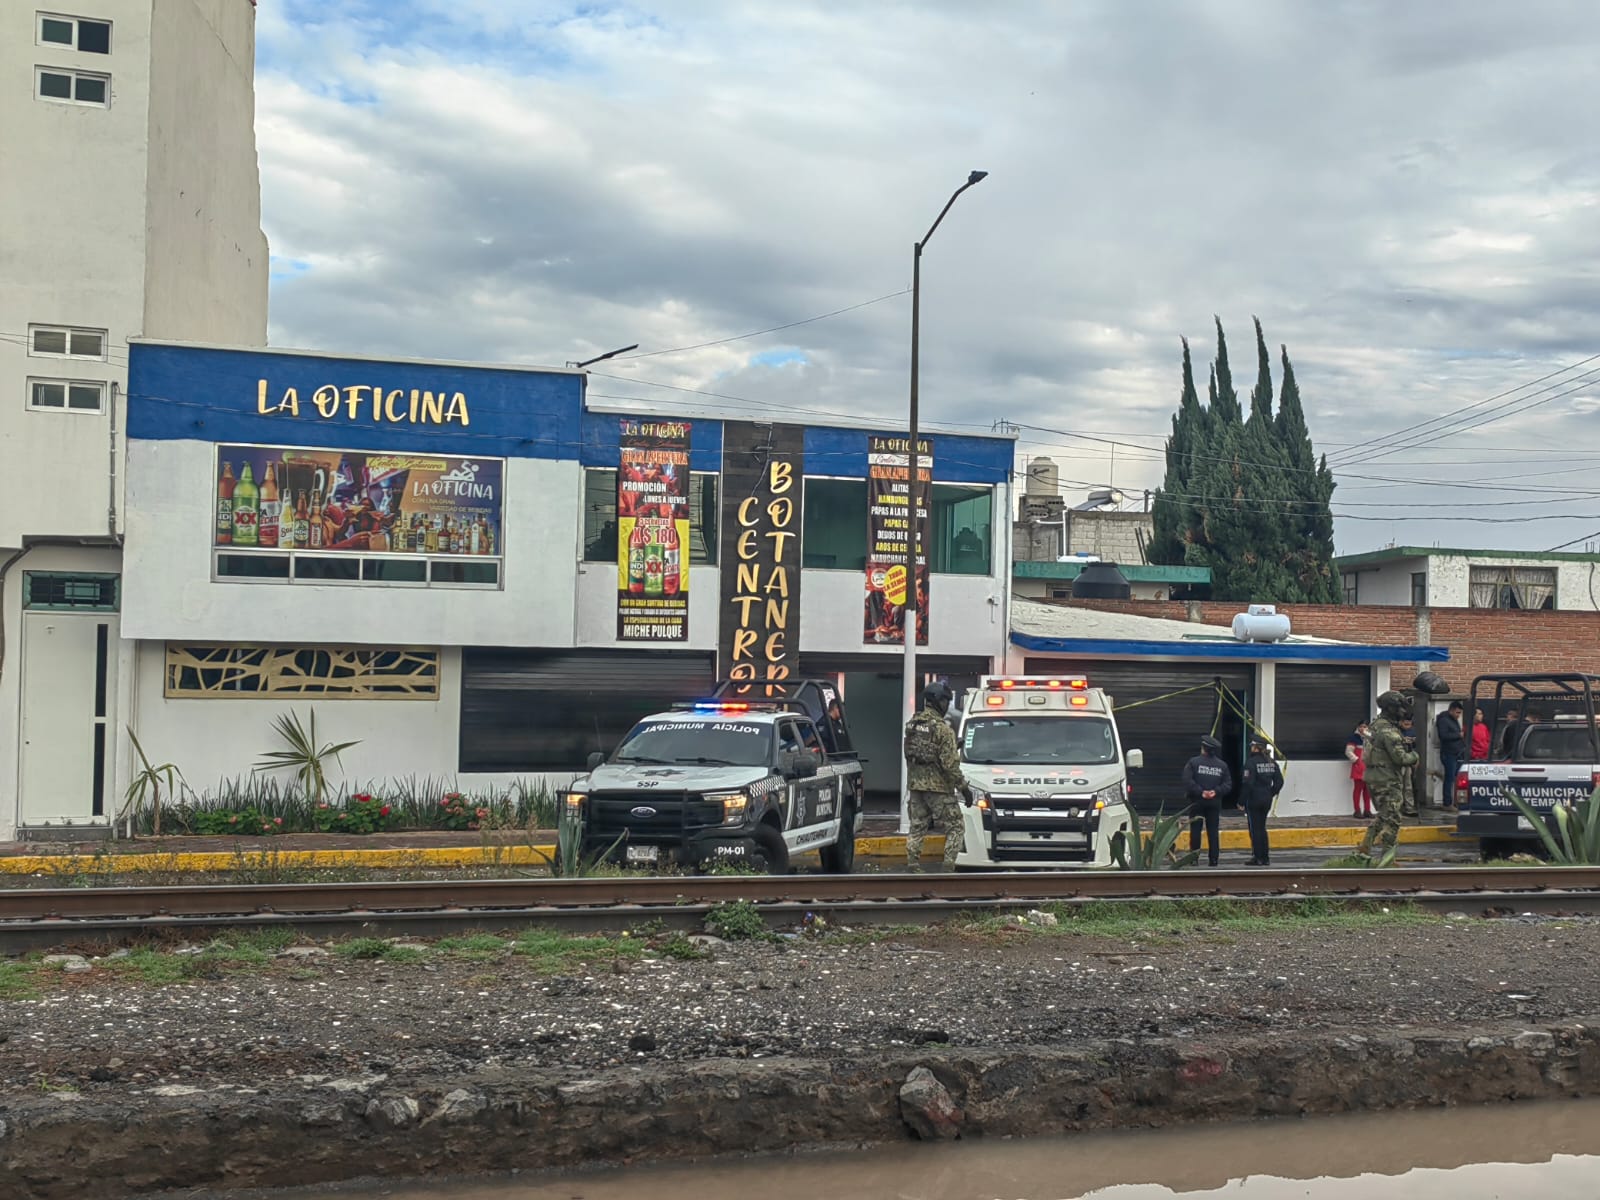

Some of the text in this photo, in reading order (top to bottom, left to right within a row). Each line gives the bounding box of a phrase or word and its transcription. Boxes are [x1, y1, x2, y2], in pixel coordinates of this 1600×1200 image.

[257, 379, 469, 426] LA OFICINA
[888, 439, 928, 453] OFICNA
[413, 480, 493, 500] LA OFICINA
[623, 481, 667, 493] PROMOCIÓN
[655, 528, 676, 544] 180
[730, 496, 763, 694] CENTRO
[624, 625, 682, 639] MICHE PULQUE
[992, 777, 1089, 785] SEMEFO
[1521, 787, 1591, 798] MUNICIPAL
[1490, 797, 1570, 807] CHITEMPAN
[718, 846, 745, 855] PM-01
